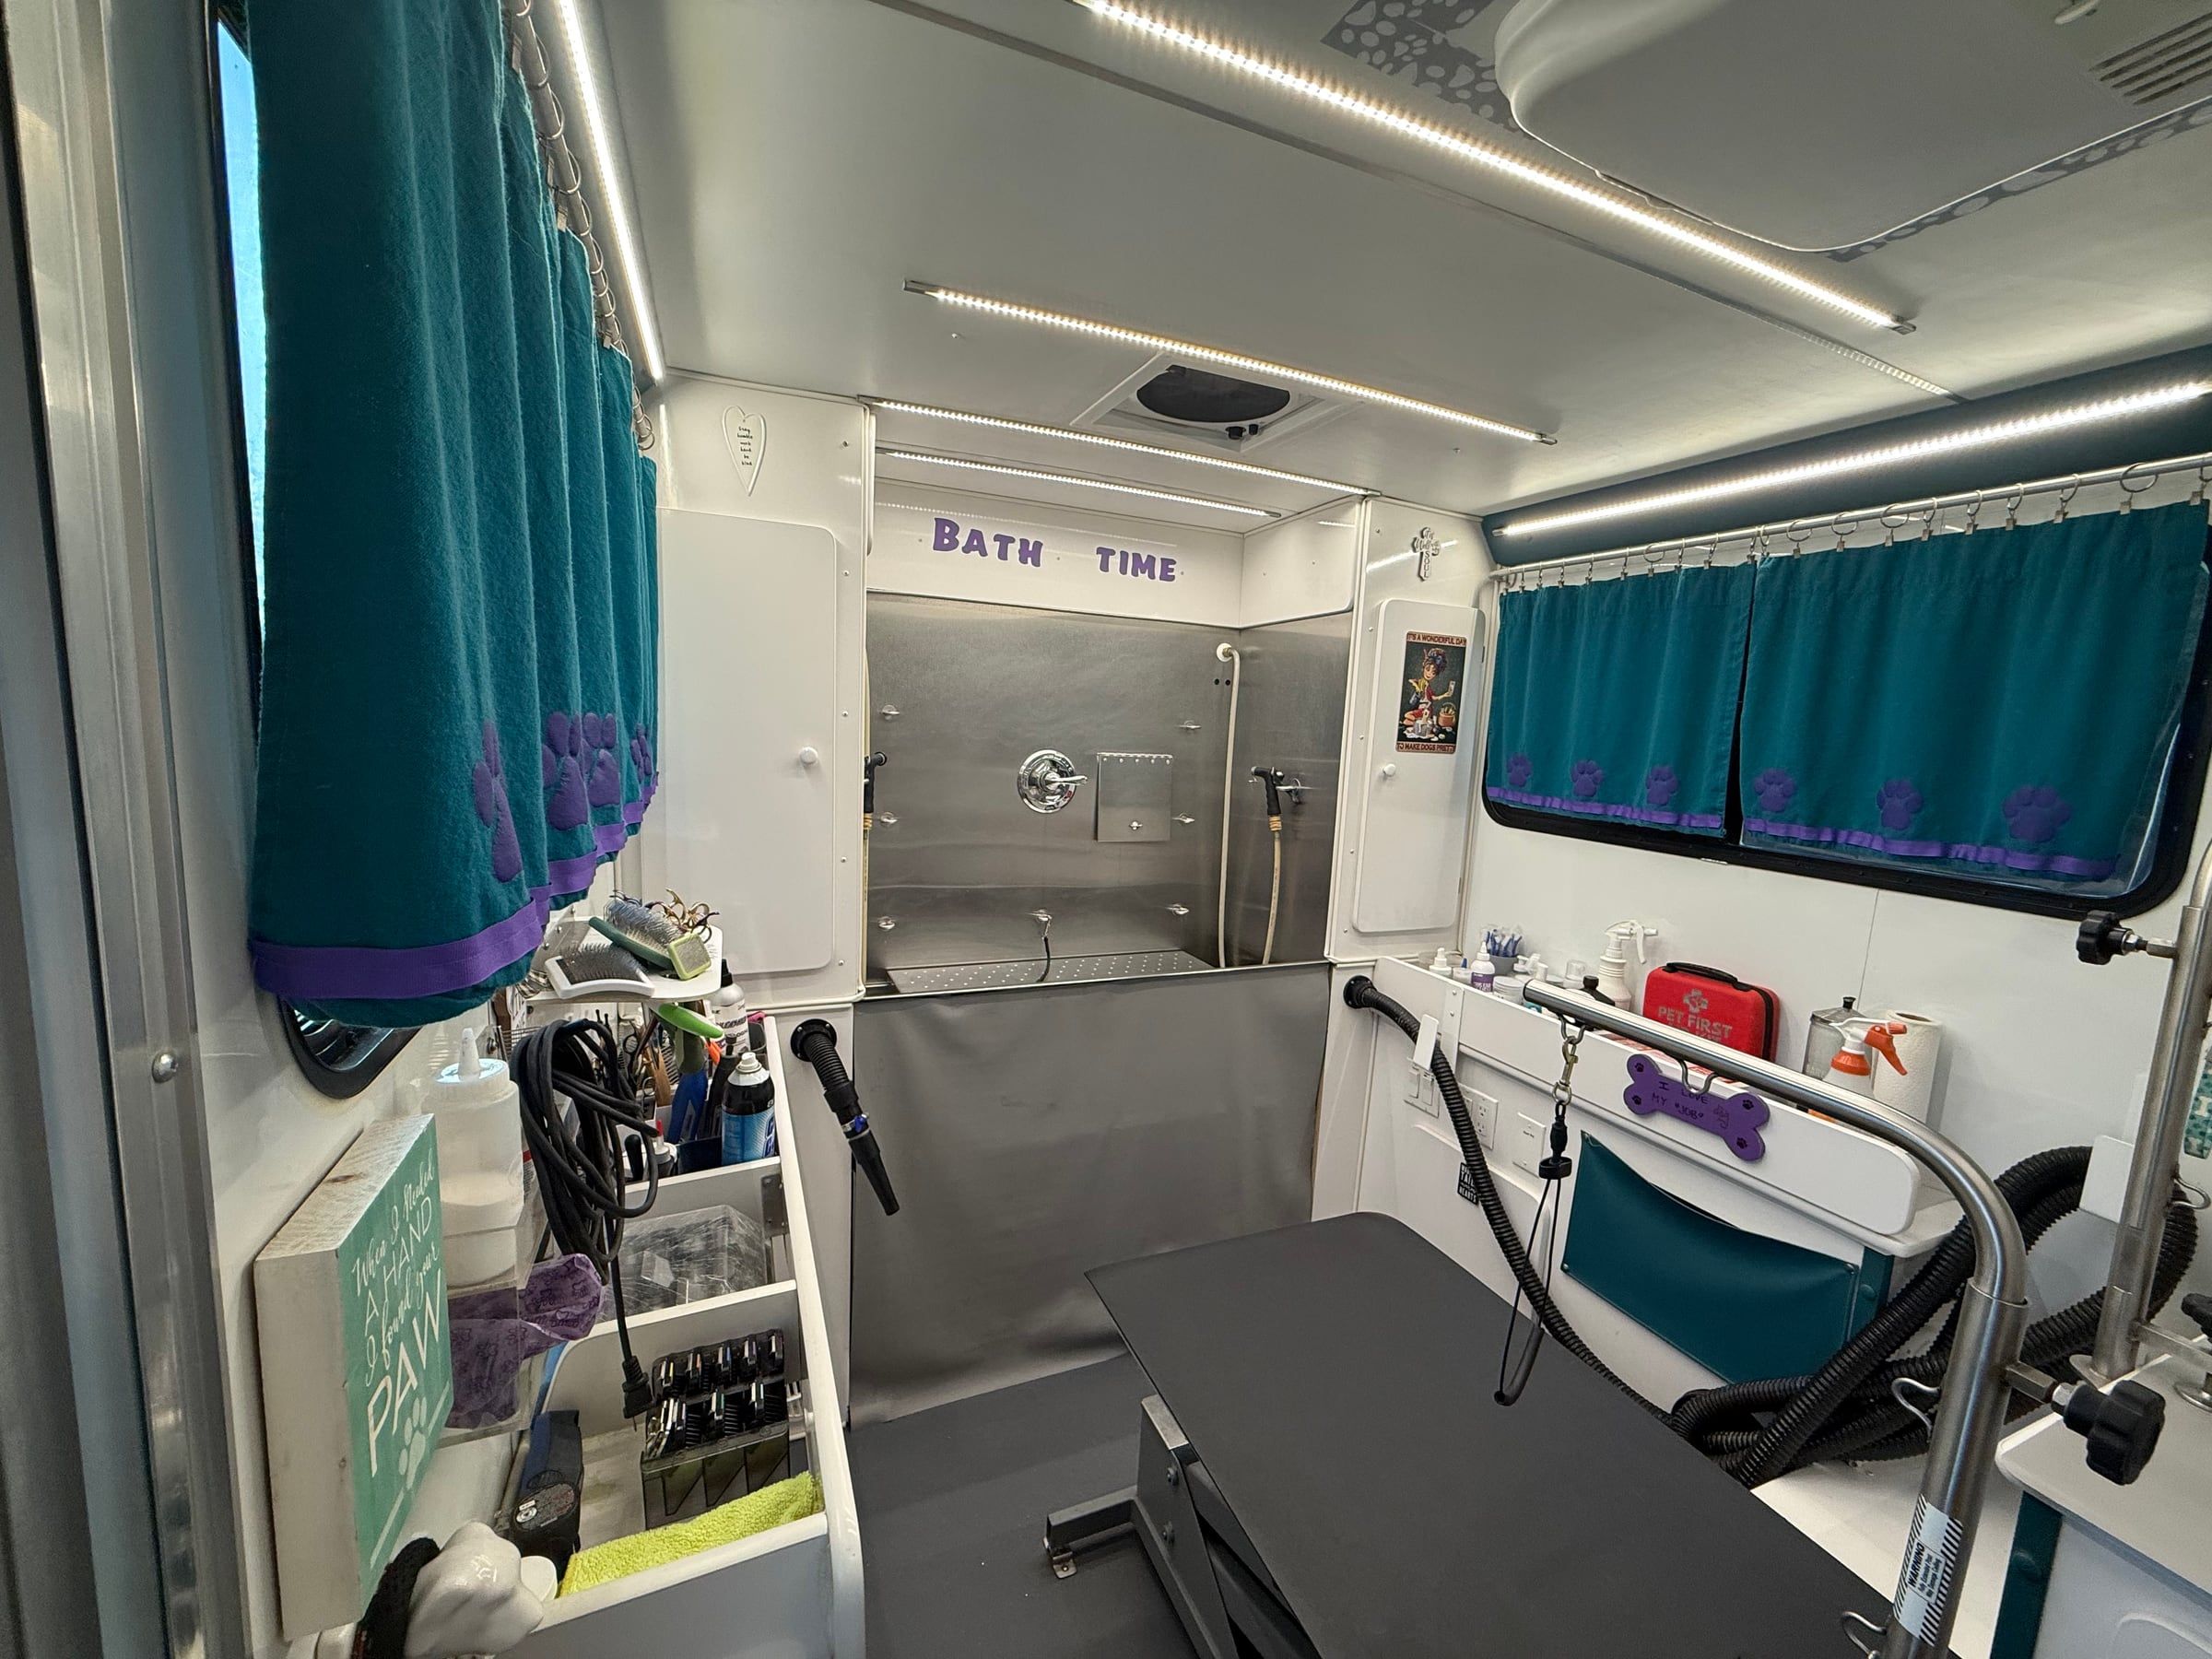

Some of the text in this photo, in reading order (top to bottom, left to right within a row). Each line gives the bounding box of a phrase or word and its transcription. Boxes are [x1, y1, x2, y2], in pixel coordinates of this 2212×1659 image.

[932, 517, 1178, 582] BATH TIME
[1658, 1006, 1684, 1024] PET
[1688, 1014, 1733, 1039] FIRST
[1651, 1092, 1667, 1106] MY
[1659, 1081, 1669, 1091] I
[351, 1238, 388, 1298] When
[365, 1195, 432, 1336] A HAND
[381, 1265, 412, 1371] found
[416, 1240, 440, 1311] your
[367, 1266, 441, 1478] PAW
[1907, 1541, 1925, 1588] WARNING
